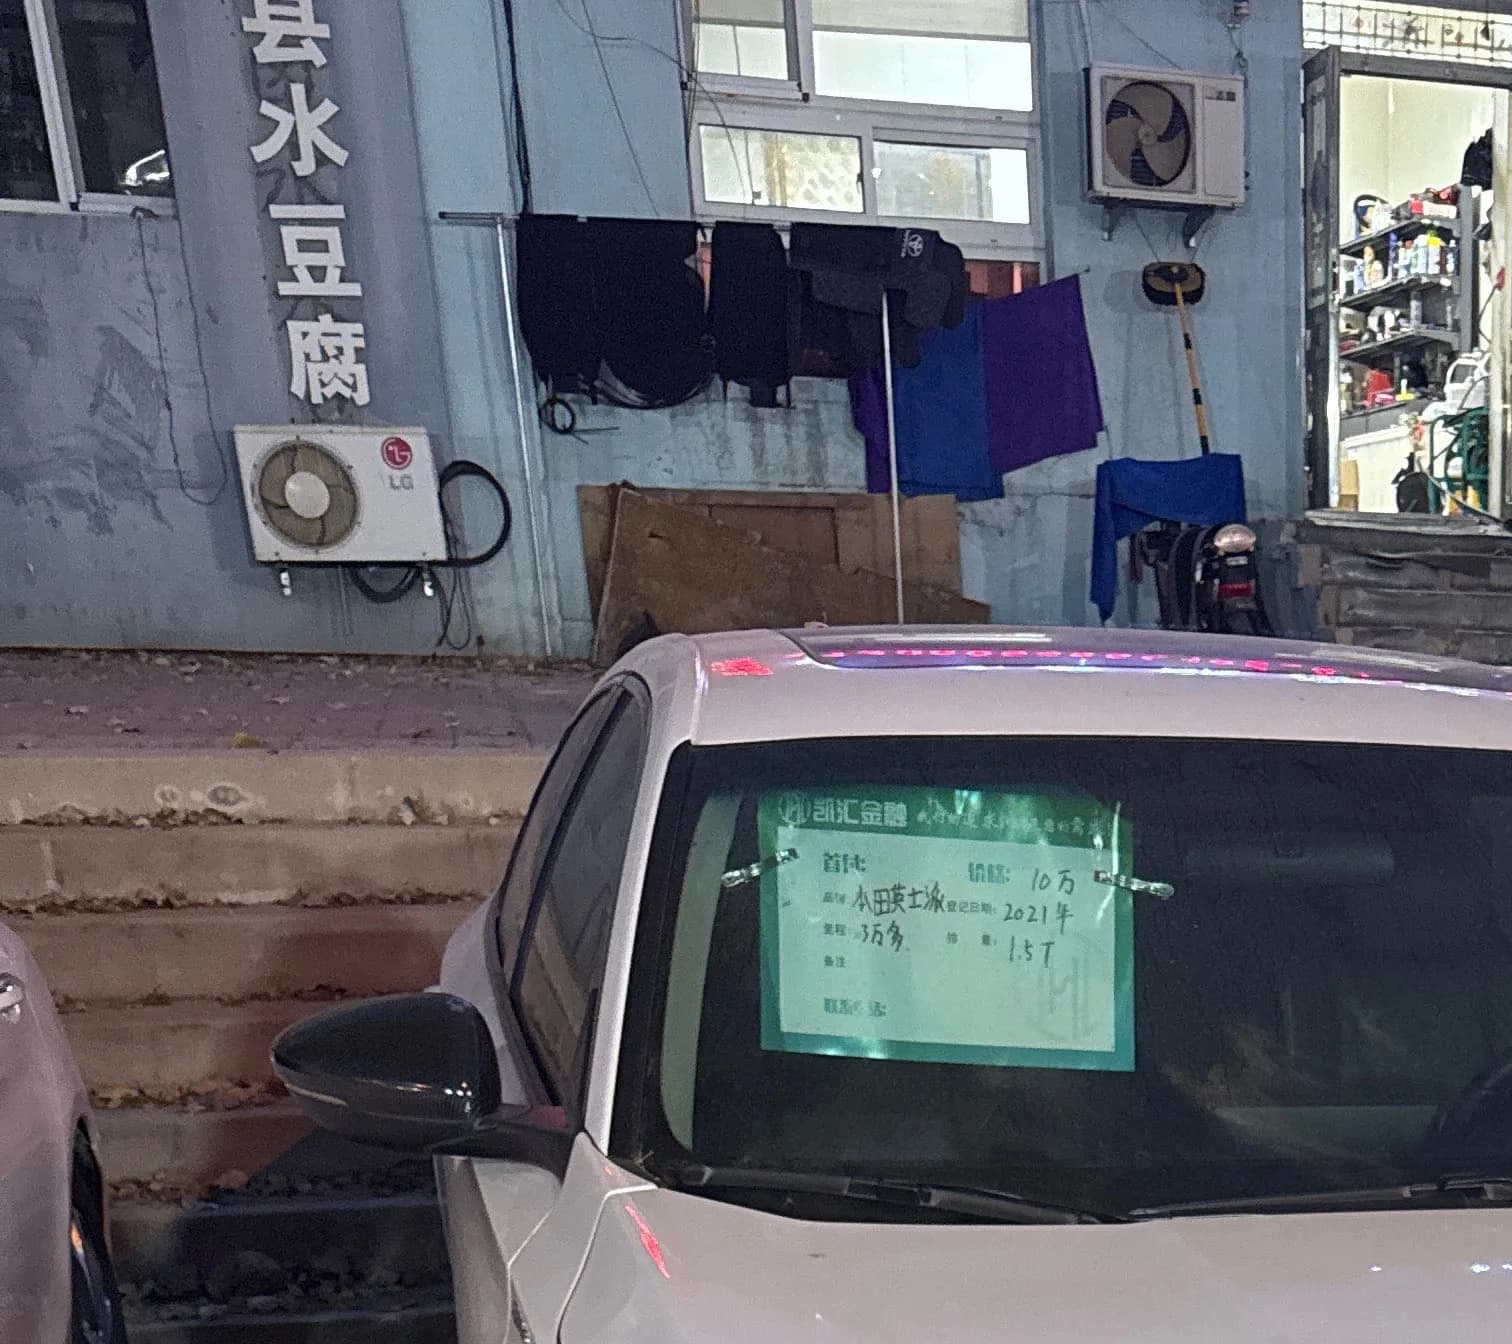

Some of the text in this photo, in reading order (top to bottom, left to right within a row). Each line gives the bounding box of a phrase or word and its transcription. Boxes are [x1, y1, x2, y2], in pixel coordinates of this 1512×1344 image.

[389, 474, 414, 490] LG
[813, 798, 908, 828] 凯汇金融
[1031, 868, 1075, 895] 10万
[1003, 901, 1074, 935] 2021年
[1009, 935, 1055, 969] 1.5T
